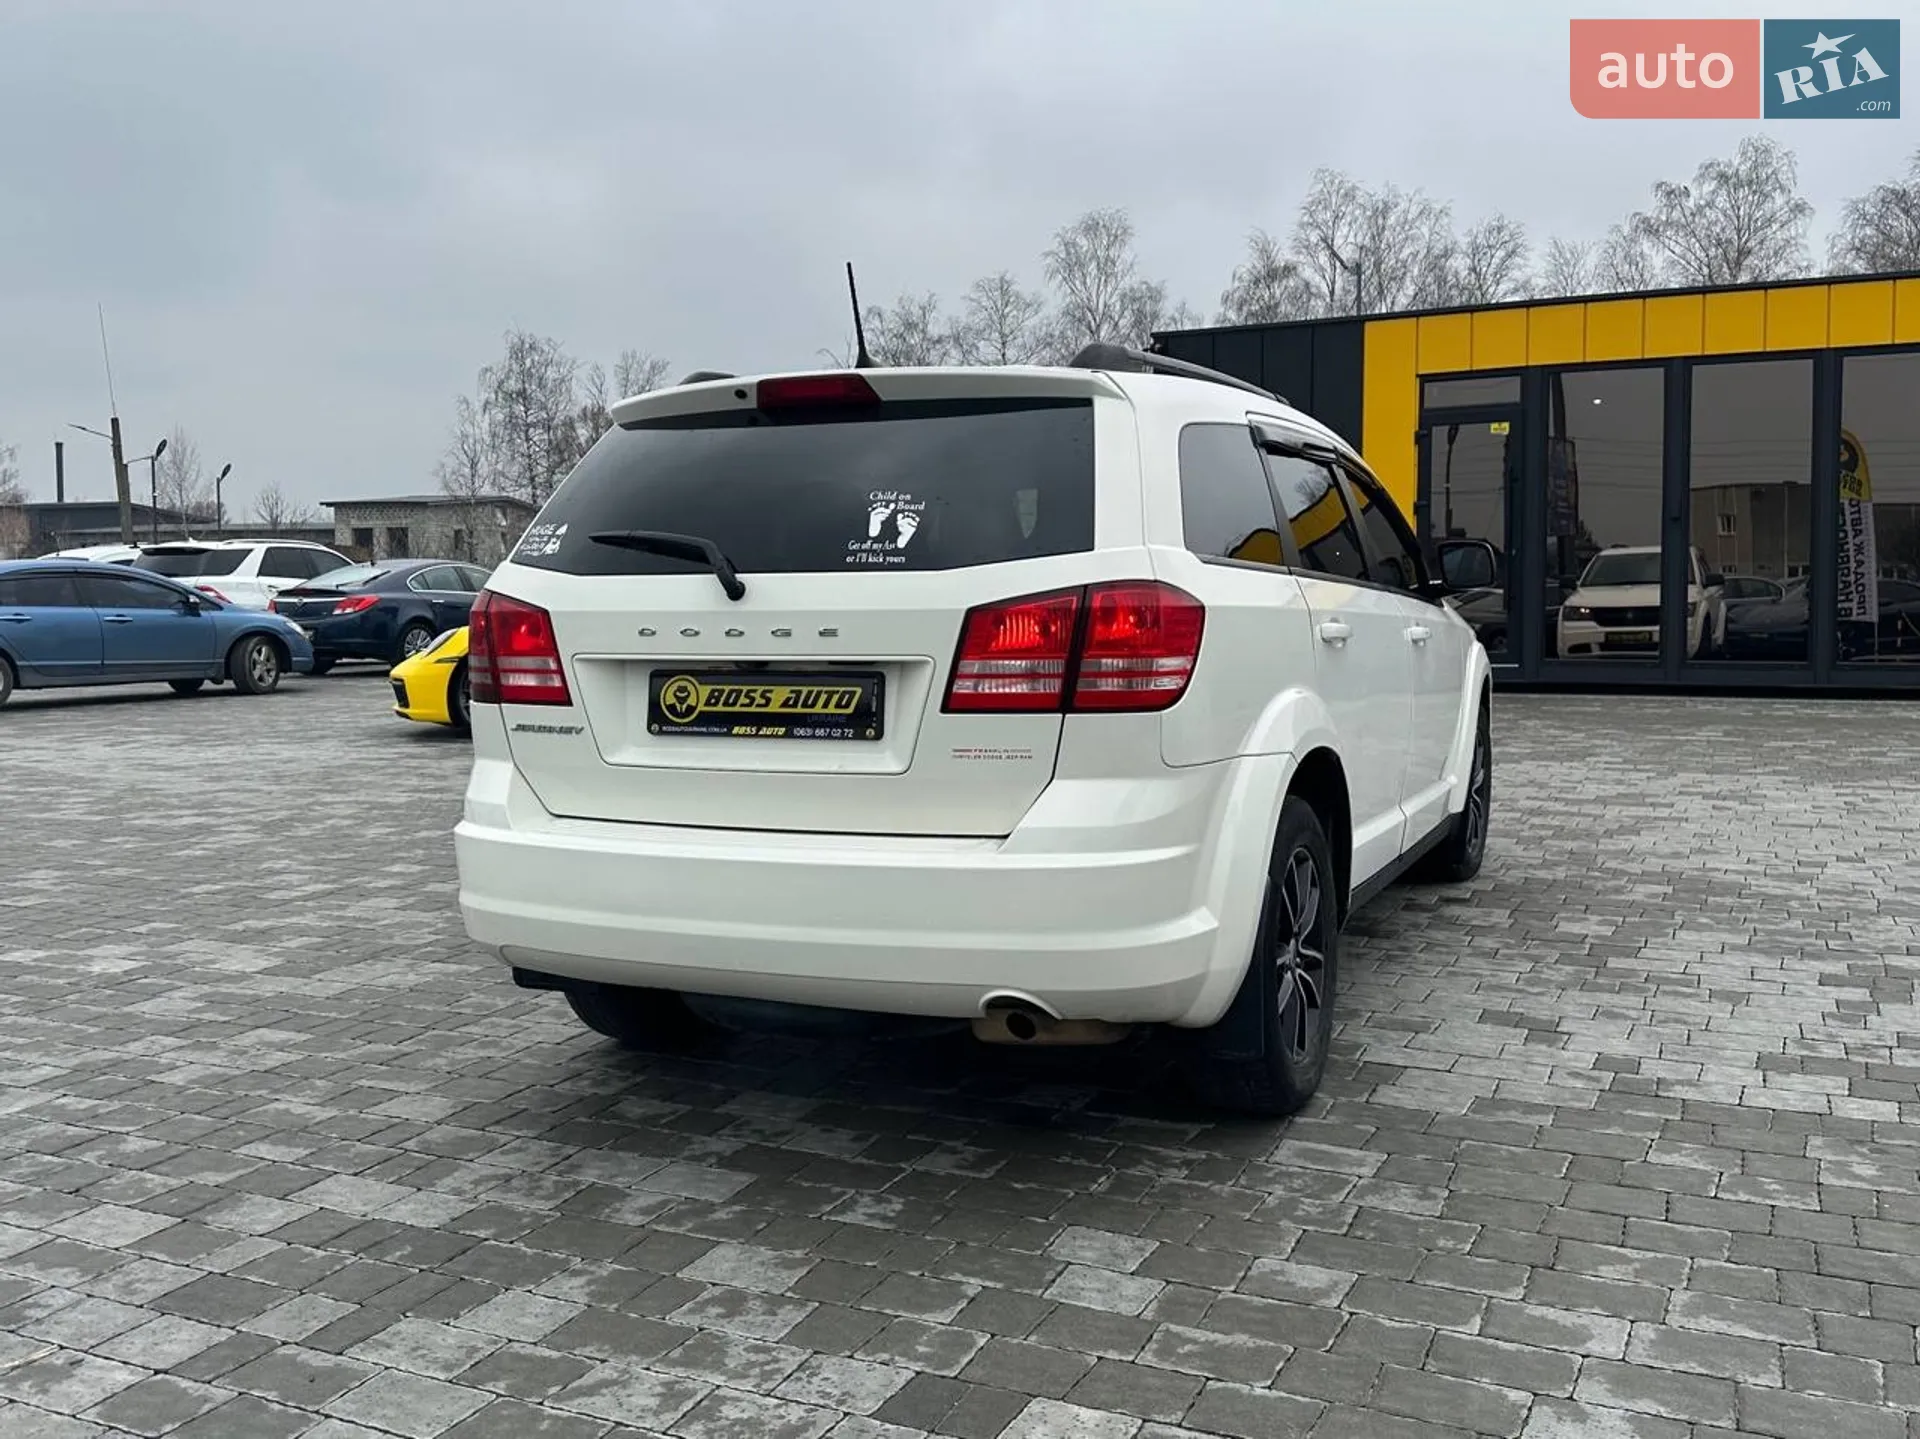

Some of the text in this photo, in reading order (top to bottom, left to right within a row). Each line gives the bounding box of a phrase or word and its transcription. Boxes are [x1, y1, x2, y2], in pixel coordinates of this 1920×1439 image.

[869, 492, 912, 501] Child on
[897, 501, 926, 510] Board
[637, 627, 839, 638] DODGE
[703, 687, 775, 708] BOSS
[778, 688, 858, 710] AUTO
[510, 723, 585, 735] JOURNEY
[732, 726, 757, 735] BOSS
[758, 727, 786, 736] AUTO
